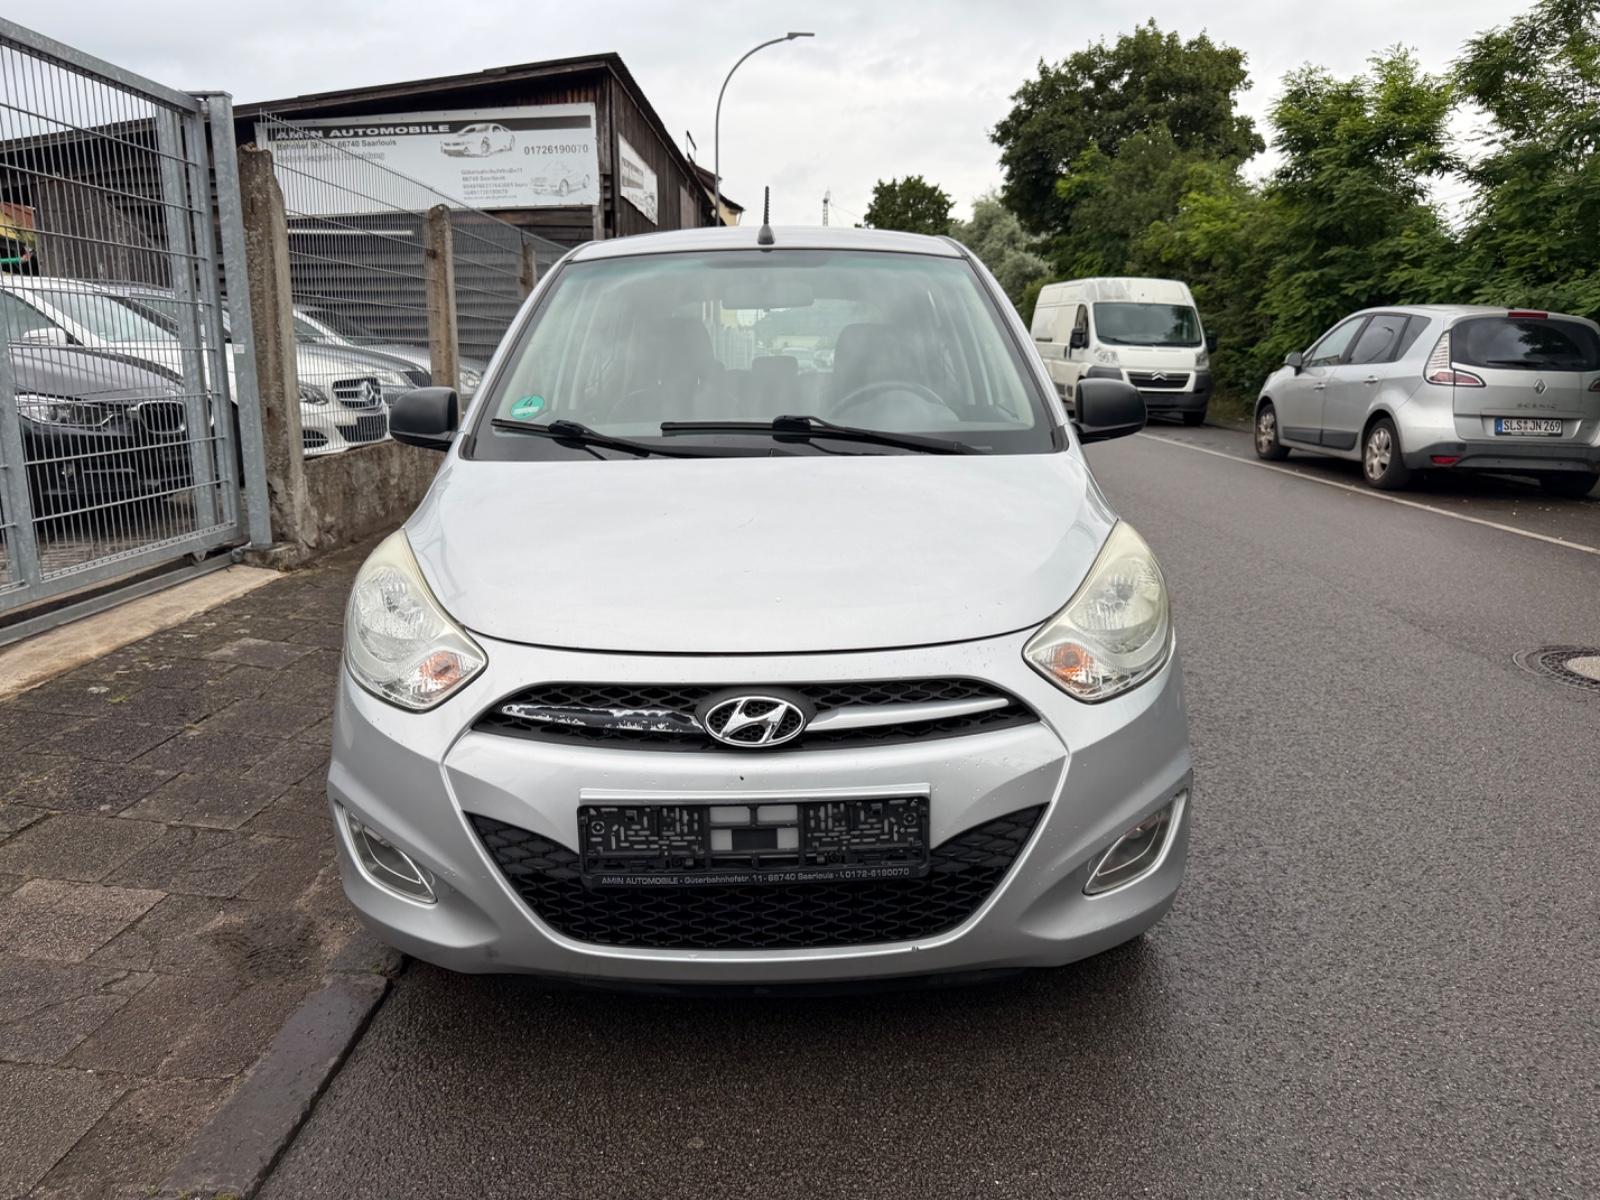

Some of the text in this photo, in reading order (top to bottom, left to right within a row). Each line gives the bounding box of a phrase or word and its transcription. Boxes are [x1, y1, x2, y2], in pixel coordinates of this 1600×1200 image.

[329, 124, 450, 138] AUTOMOBILE
[361, 138, 397, 147] Saarlouis
[523, 144, 589, 155] 01726190070
[1503, 419, 1561, 432] SLS JN 269
[601, 876, 624, 885] AMIN
[626, 876, 678, 885] AUTOMOBILE
[798, 871, 834, 880] Saarlouis
